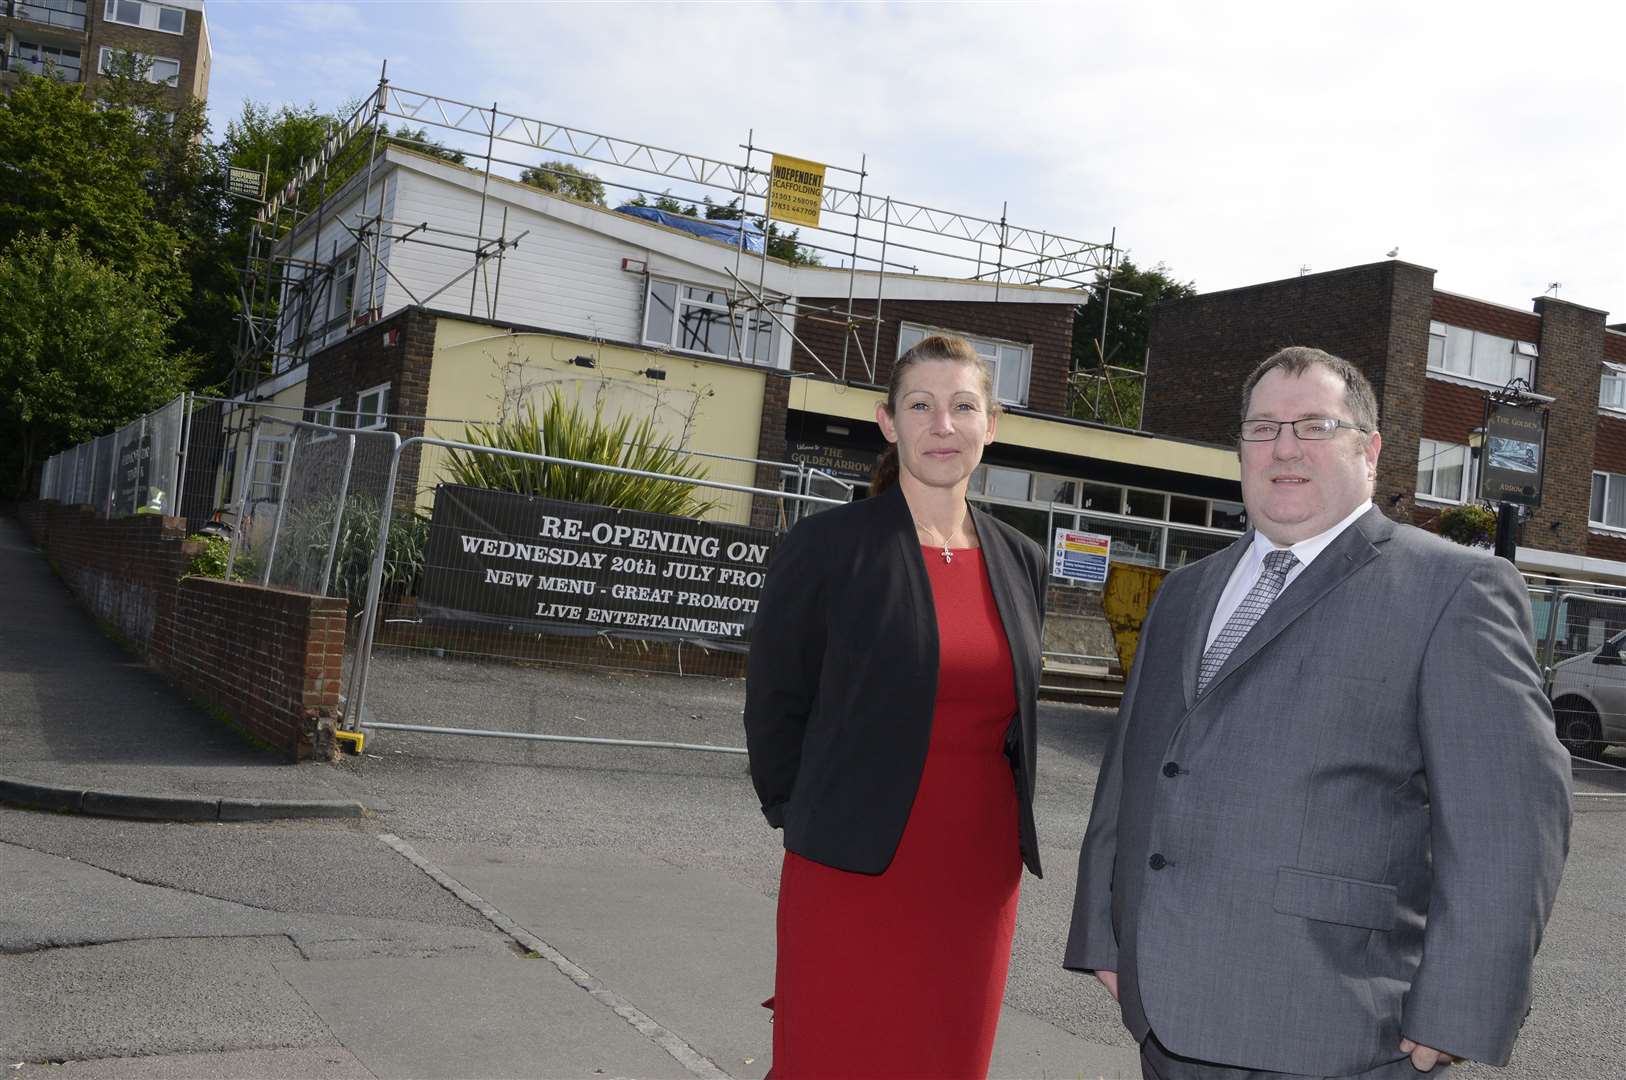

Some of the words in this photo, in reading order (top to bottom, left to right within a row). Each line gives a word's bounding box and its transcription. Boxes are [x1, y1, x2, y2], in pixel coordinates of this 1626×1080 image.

[773, 165, 823, 187] INDEPENDENT
[773, 179, 821, 197] SCAFFOLDING
[791, 452, 833, 466] GOLDEN
[833, 459, 872, 472] ARROW
[823, 447, 844, 458] THE
[539, 515, 720, 559] RE-OPENING
[727, 541, 770, 564] ON
[461, 535, 607, 570] WEDNESDAY
[611, 556, 657, 576] 20th
[662, 561, 715, 582] JULY
[717, 568, 767, 589] FRO
[484, 568, 534, 588] NEW
[536, 575, 597, 596] MENU
[612, 584, 673, 604] GREAT
[536, 602, 583, 620] LIVE
[585, 607, 745, 637] ENTERTAINMENT
